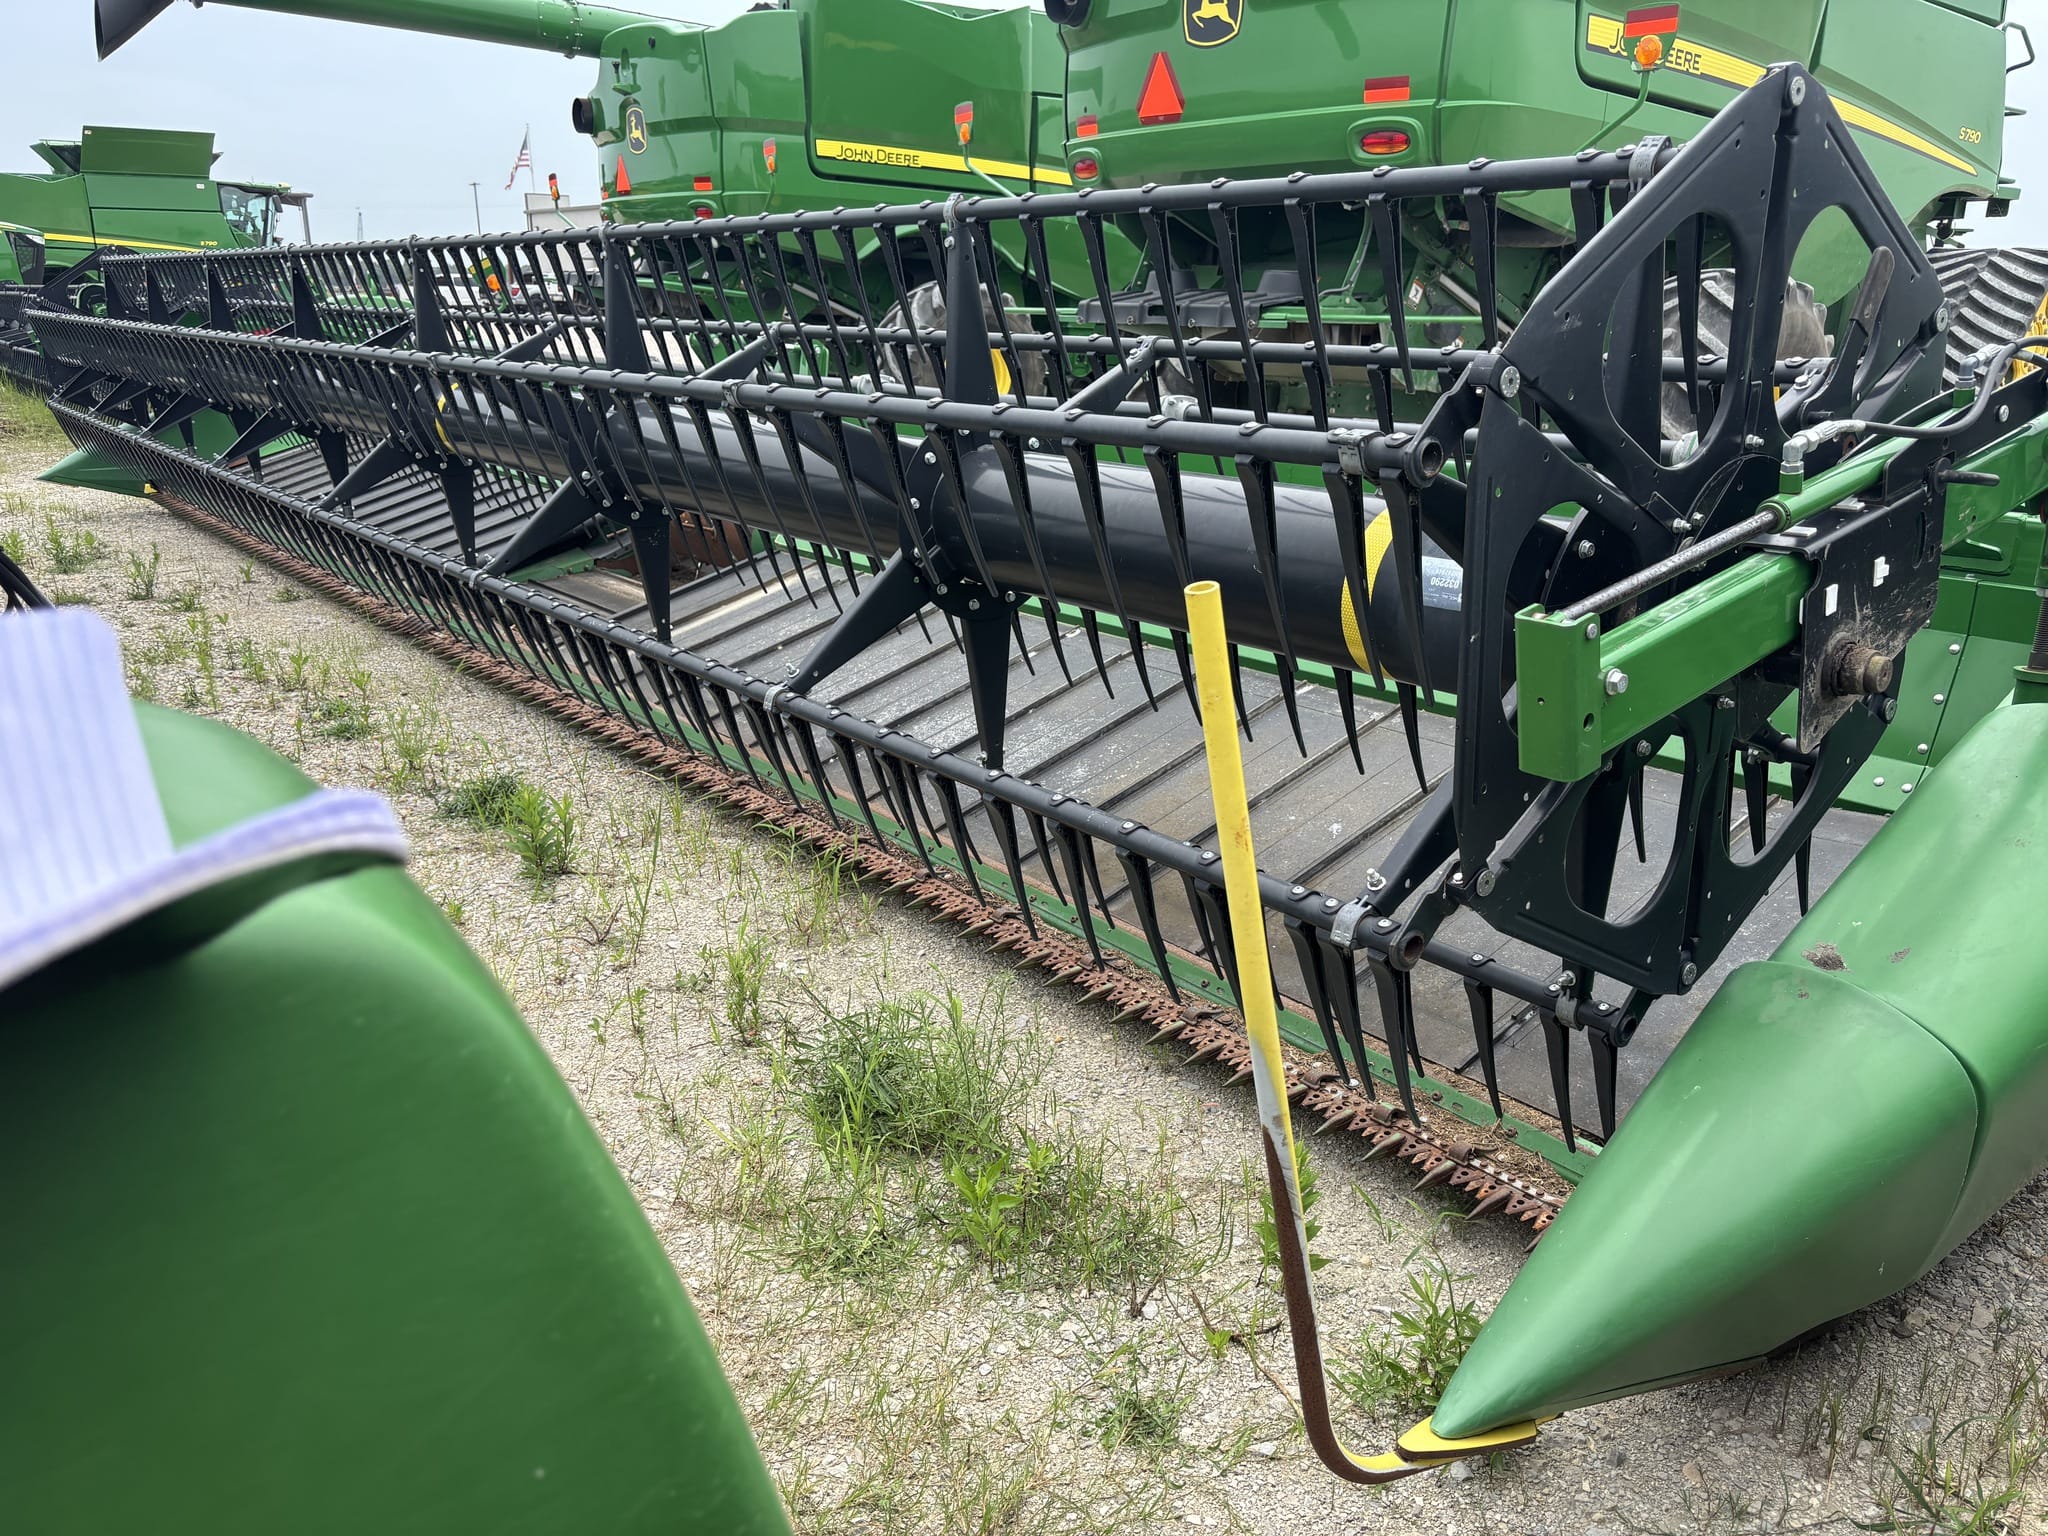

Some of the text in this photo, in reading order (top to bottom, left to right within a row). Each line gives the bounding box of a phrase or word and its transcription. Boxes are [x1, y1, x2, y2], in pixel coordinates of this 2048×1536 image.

[1664, 47, 1702, 71] EERE
[1959, 126, 1982, 144] S790
[836, 145, 920, 165] JOHN DEERE
